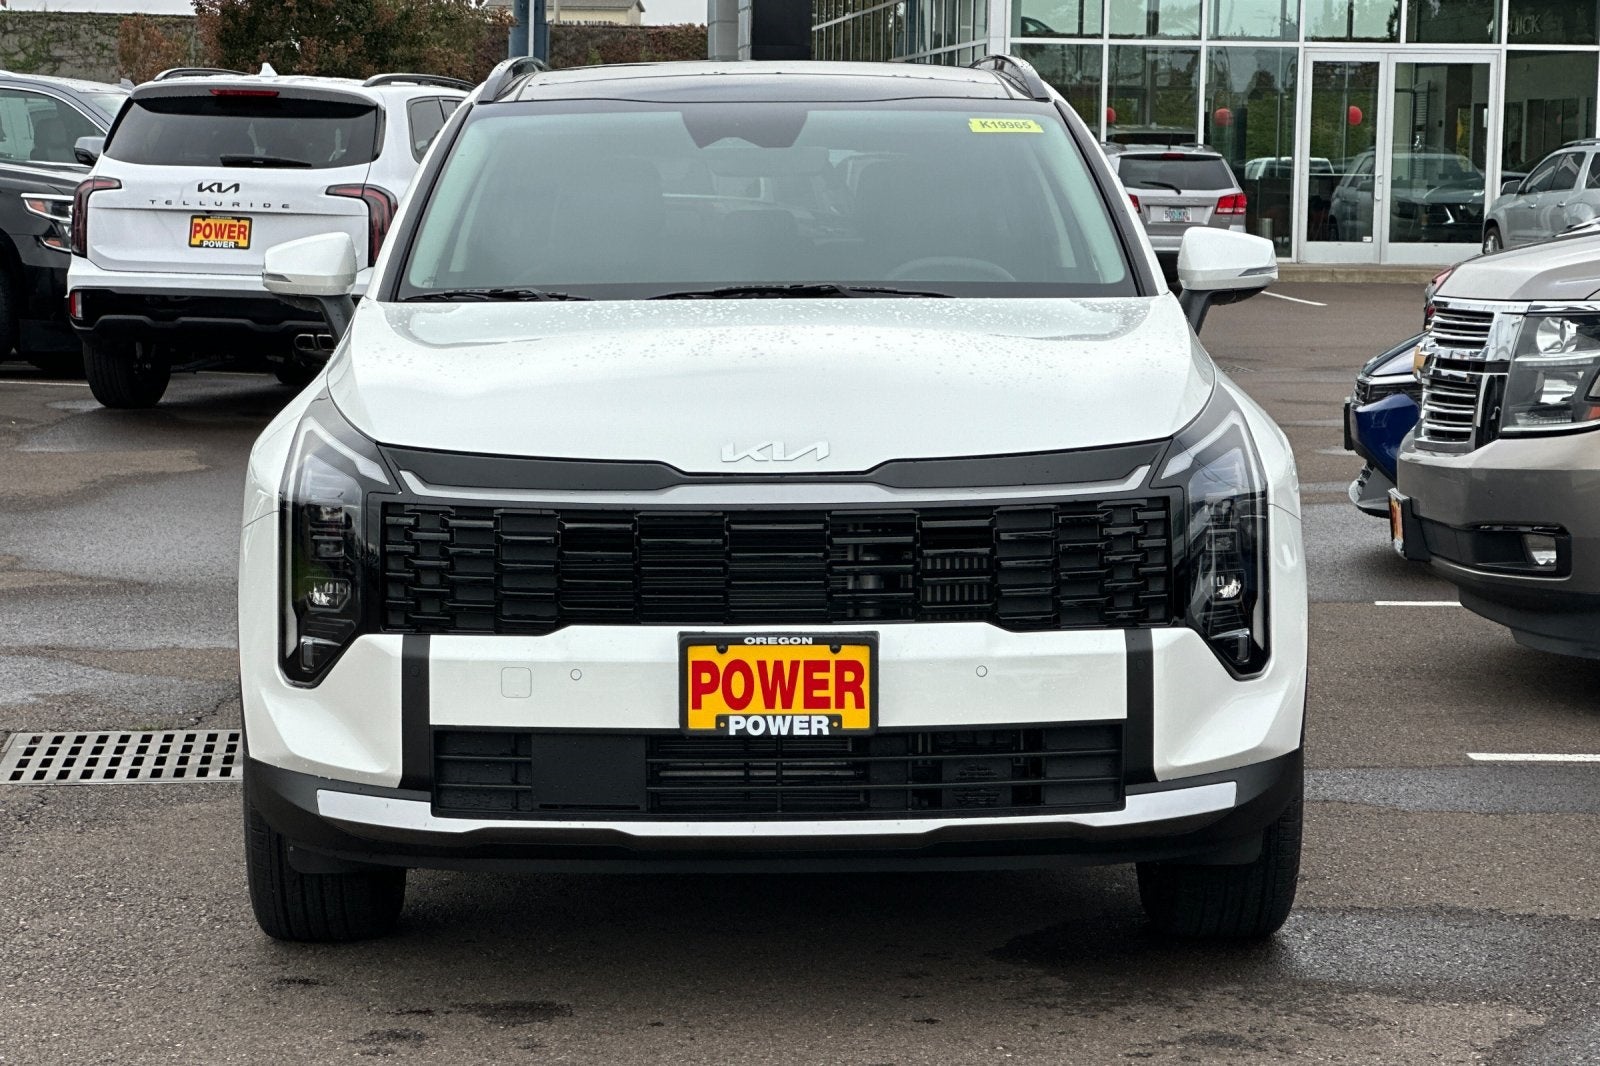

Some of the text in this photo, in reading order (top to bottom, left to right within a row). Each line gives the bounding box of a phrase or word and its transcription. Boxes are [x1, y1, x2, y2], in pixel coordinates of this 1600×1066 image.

[1507, 14, 1541, 35] UICK
[979, 120, 1032, 129] K19965
[197, 182, 240, 193] KIA
[149, 199, 290, 209] TELLURIDE
[192, 222, 248, 240] POWER
[203, 240, 235, 248] POWER
[721, 440, 830, 462] KIA
[743, 636, 813, 645] OREGON
[691, 658, 865, 710] POWER
[728, 715, 830, 736] POWER
